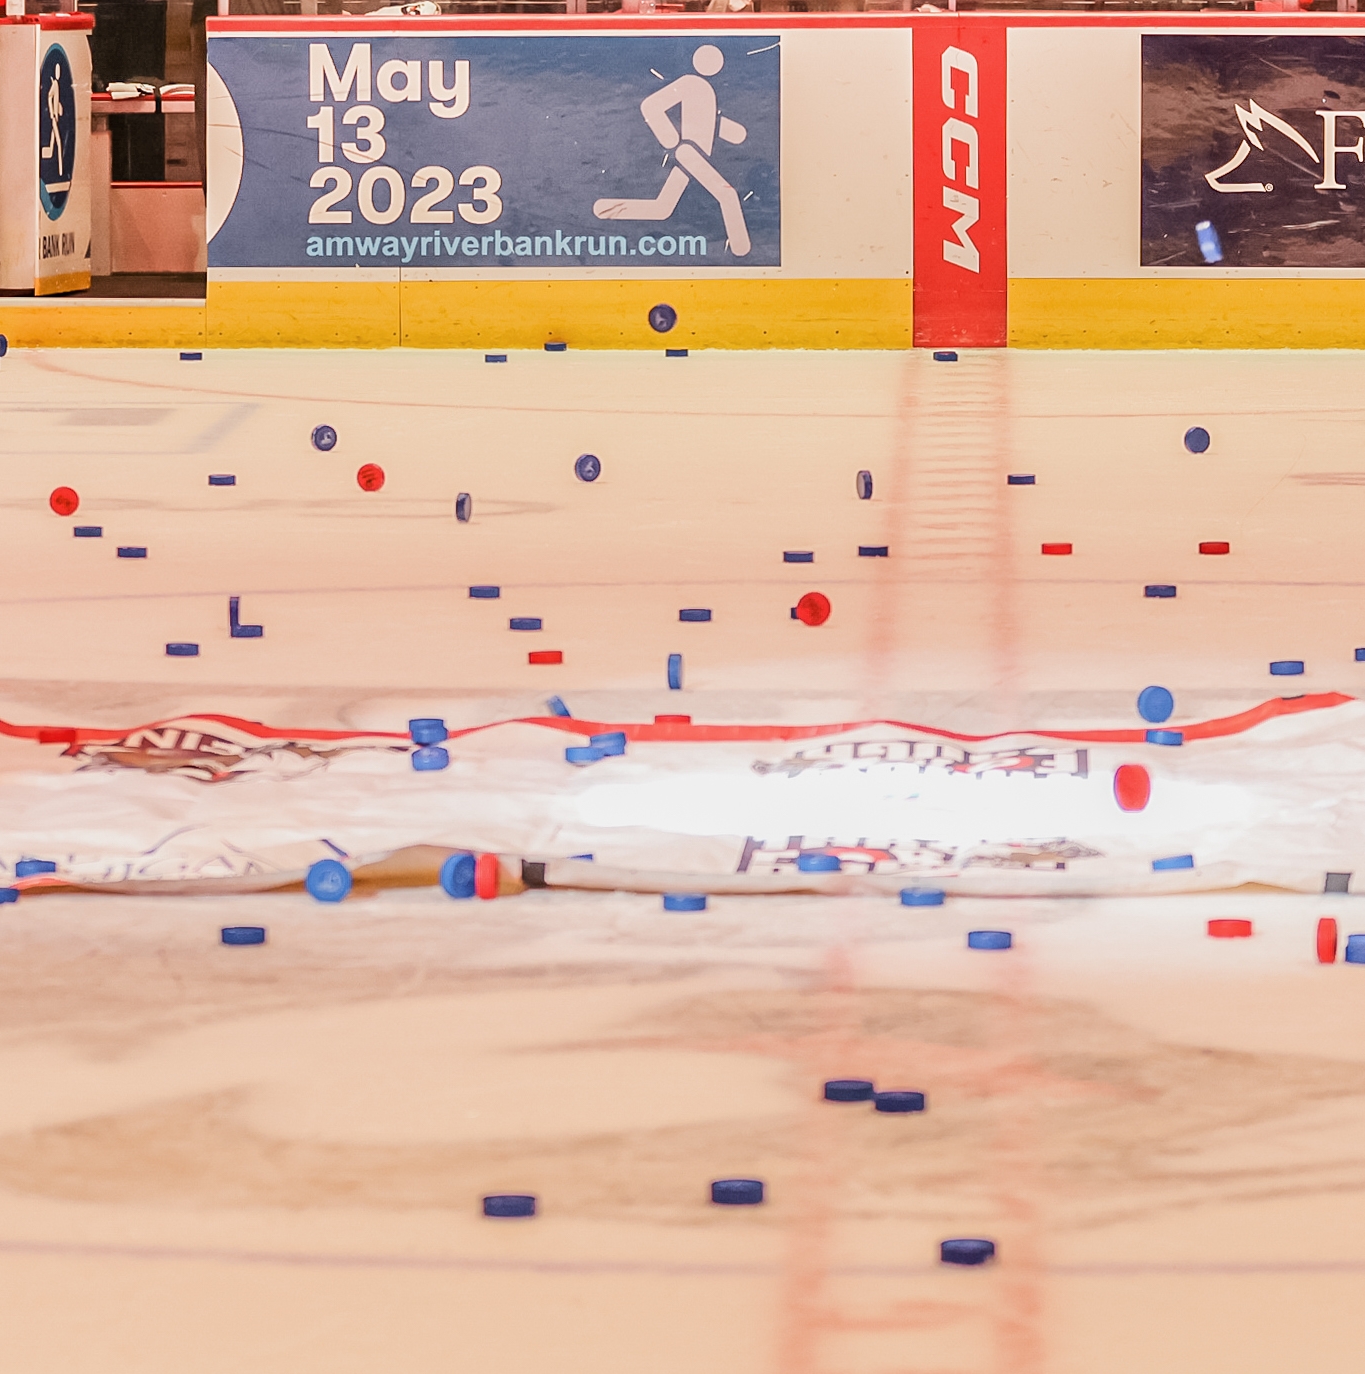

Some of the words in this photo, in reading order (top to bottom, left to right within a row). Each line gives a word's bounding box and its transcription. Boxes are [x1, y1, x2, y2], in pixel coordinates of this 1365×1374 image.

[308, 42, 471, 120] May
[307, 104, 386, 165] 13
[939, 43, 981, 274] CCM
[307, 165, 504, 226] 2023
[305, 228, 708, 265] amwayriverbankrun.com
